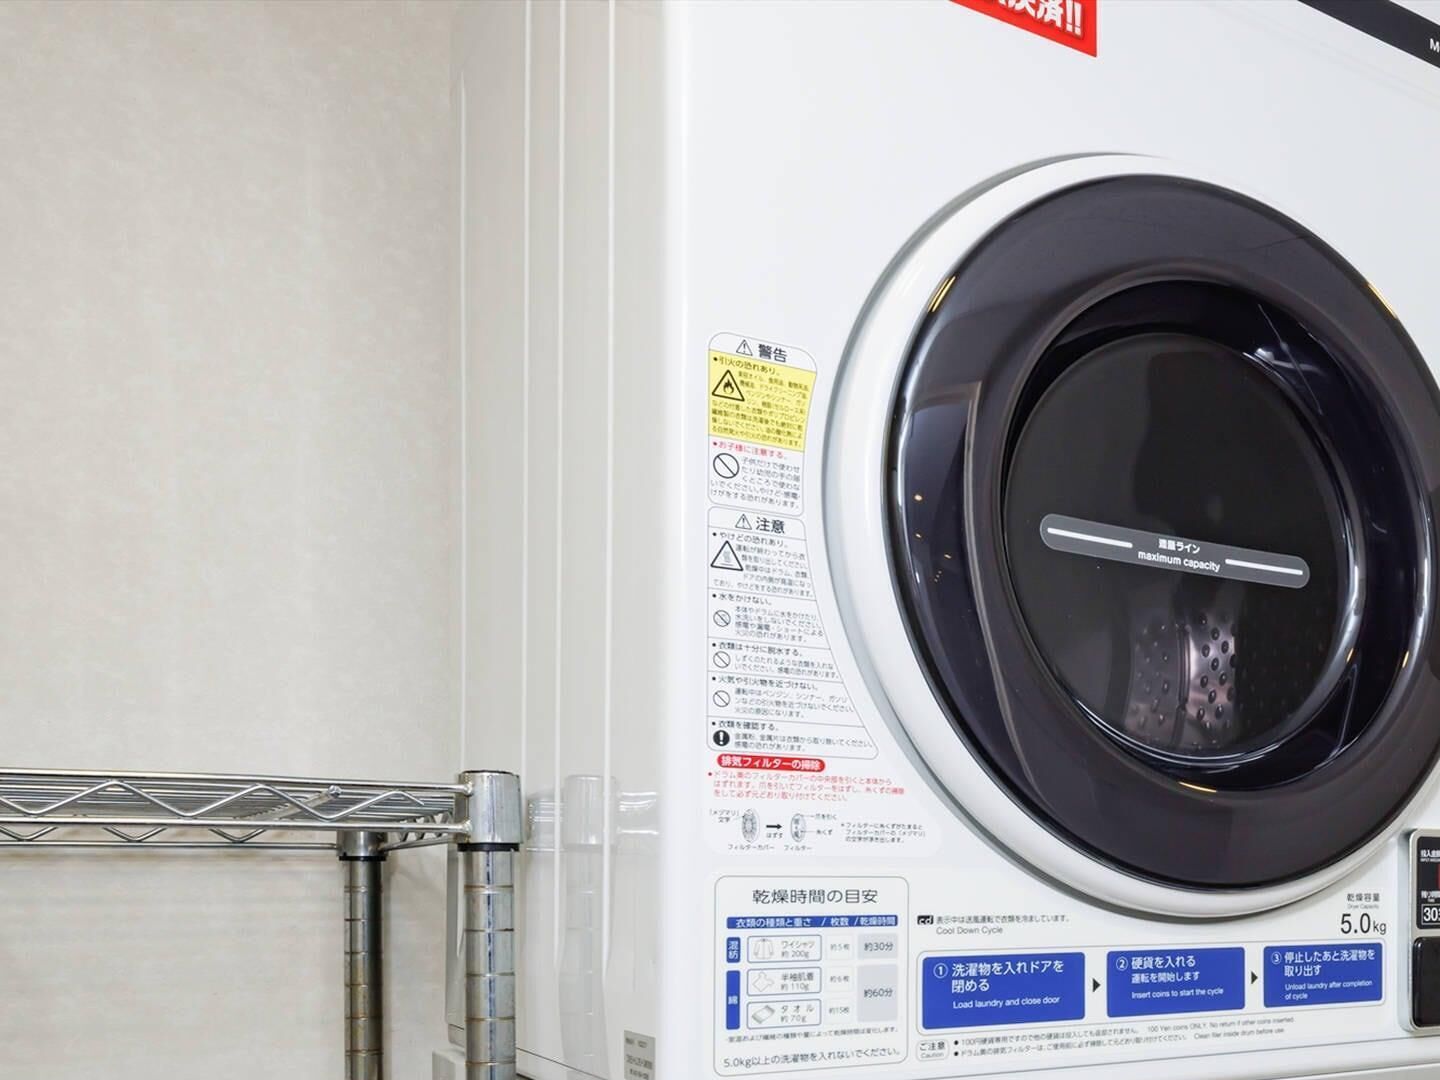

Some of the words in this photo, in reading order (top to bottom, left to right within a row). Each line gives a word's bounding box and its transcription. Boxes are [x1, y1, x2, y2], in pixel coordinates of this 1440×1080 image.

[758, 343, 787, 363] 警告
[756, 516, 785, 534] 注意
[1138, 551, 1181, 566] maximum
[1183, 558, 1220, 573] capacity
[752, 889, 878, 904] 乾燥時間の目安
[1347, 893, 1380, 902] 乾燥容量
[736, 917, 811, 929] 衣類の種類と重さ
[860, 916, 896, 926] 乾燥時間
[1340, 912, 1387, 935] 5.0kg
[936, 926, 954, 935] Cool
[957, 926, 979, 935] Down
[981, 926, 1003, 936] Cycle
[864, 942, 893, 952] 約30分
[1131, 955, 1196, 970] 硬貨を入れる
[1284, 965, 1321, 977] 取り出す
[1131, 972, 1200, 984] 運転を開始します
[952, 979, 990, 993] 閉める
[1285, 982, 1306, 991] Unload
[1307, 981, 1328, 990] laundry
[1329, 981, 1341, 989] after
[1342, 979, 1372, 989] completion
[864, 988, 893, 998] 約60分
[1132, 990, 1150, 999] Insert
[1152, 989, 1169, 998] coins
[1171, 989, 1178, 997] to
[1179, 988, 1193, 997] start
[1195, 987, 1205, 996] the
[1207, 987, 1224, 996] cycle
[1285, 992, 1291, 1000] of
[1292, 992, 1308, 1000] cycle
[953, 1000, 973, 1009] Load
[975, 998, 1003, 1009] laundry
[1005, 997, 1020, 1006] and
[1021, 996, 1041, 1005] close
[1043, 995, 1060, 1004] door
[919, 1041, 945, 1051] ご注意
